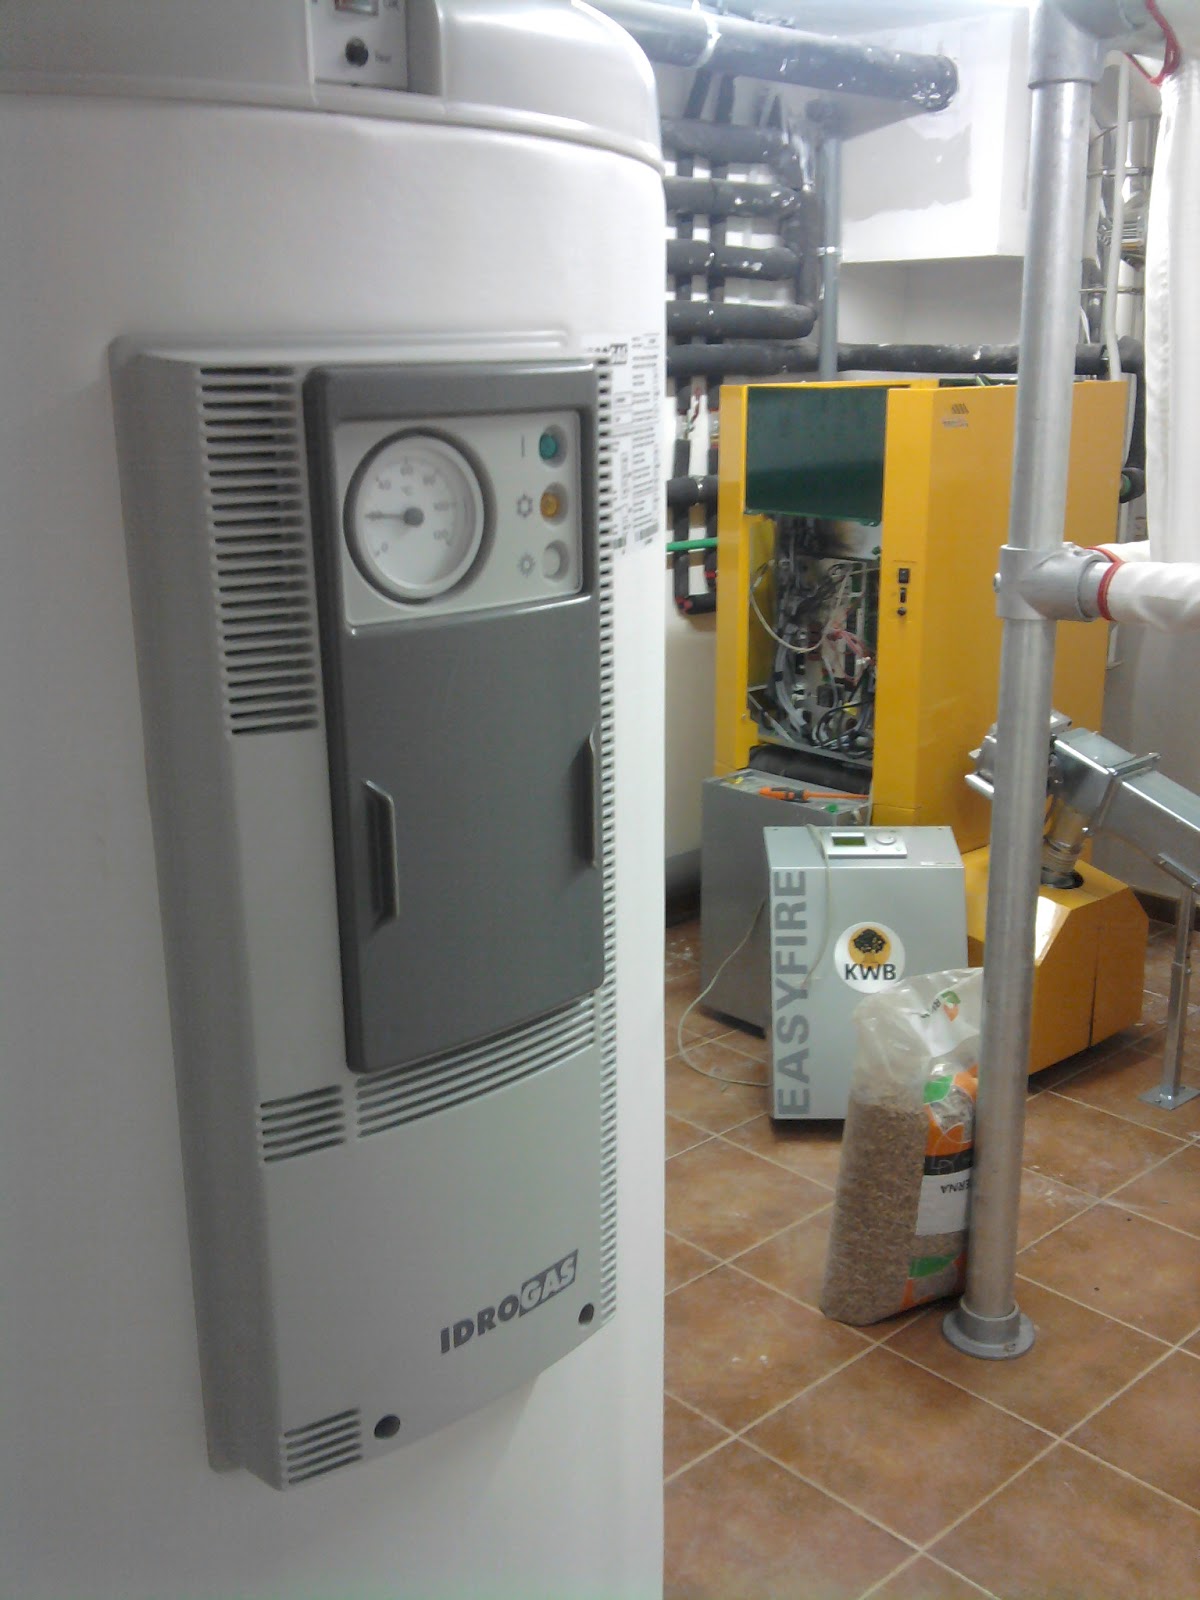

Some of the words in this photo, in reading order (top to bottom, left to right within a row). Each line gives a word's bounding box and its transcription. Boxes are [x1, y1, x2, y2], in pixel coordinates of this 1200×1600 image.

[774, 870, 811, 1115] EASYFIRE
[844, 963, 897, 981] KWB
[440, 1249, 579, 1354] IDROGAS
